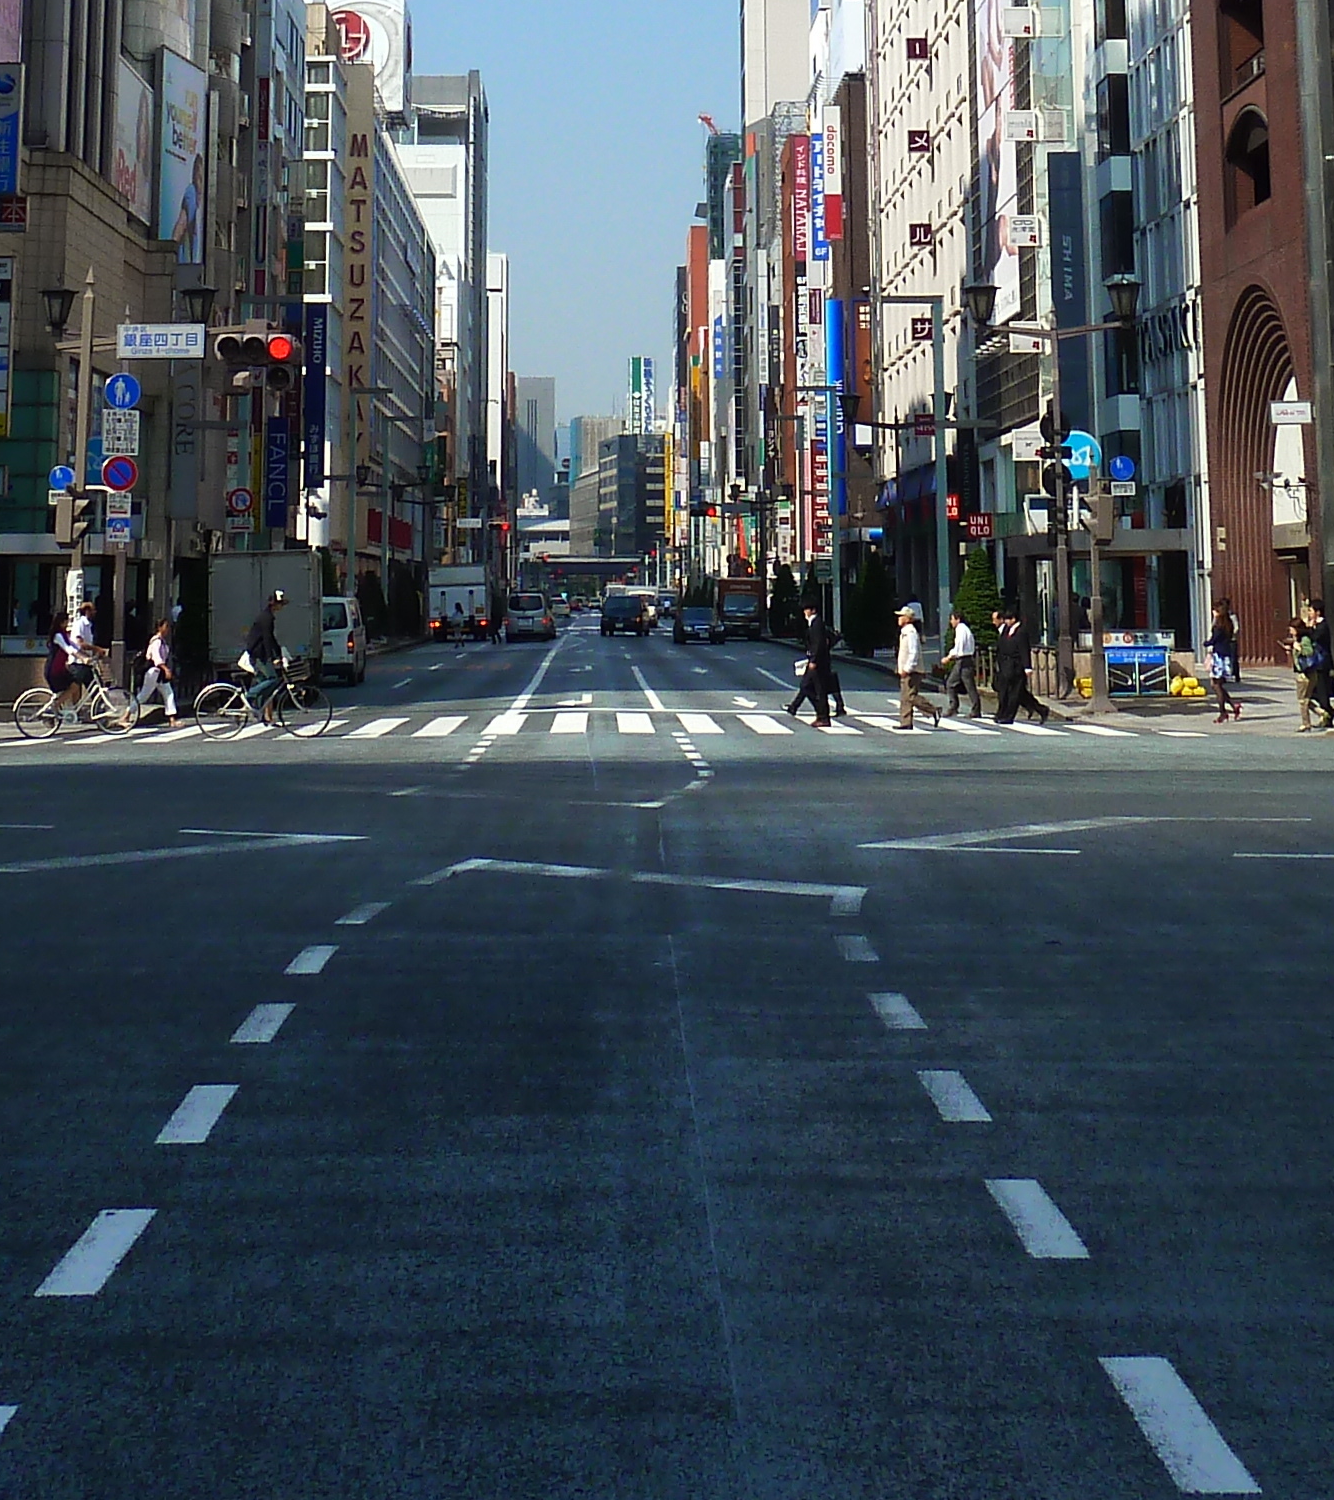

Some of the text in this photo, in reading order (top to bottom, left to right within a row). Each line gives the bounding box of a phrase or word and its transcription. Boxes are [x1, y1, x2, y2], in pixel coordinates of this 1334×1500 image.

[826, 124, 837, 176] docomo
[795, 189, 808, 251] NATARAJ
[1062, 234, 1074, 301] SHIMA
[123, 332, 199, 347] 銀座四丁目
[131, 347, 153, 355] Ginza
[313, 316, 324, 364] MIZUHO
[267, 432, 287, 512] FANCL
[970, 515, 988, 525] UNI
[970, 525, 990, 535] QLO
